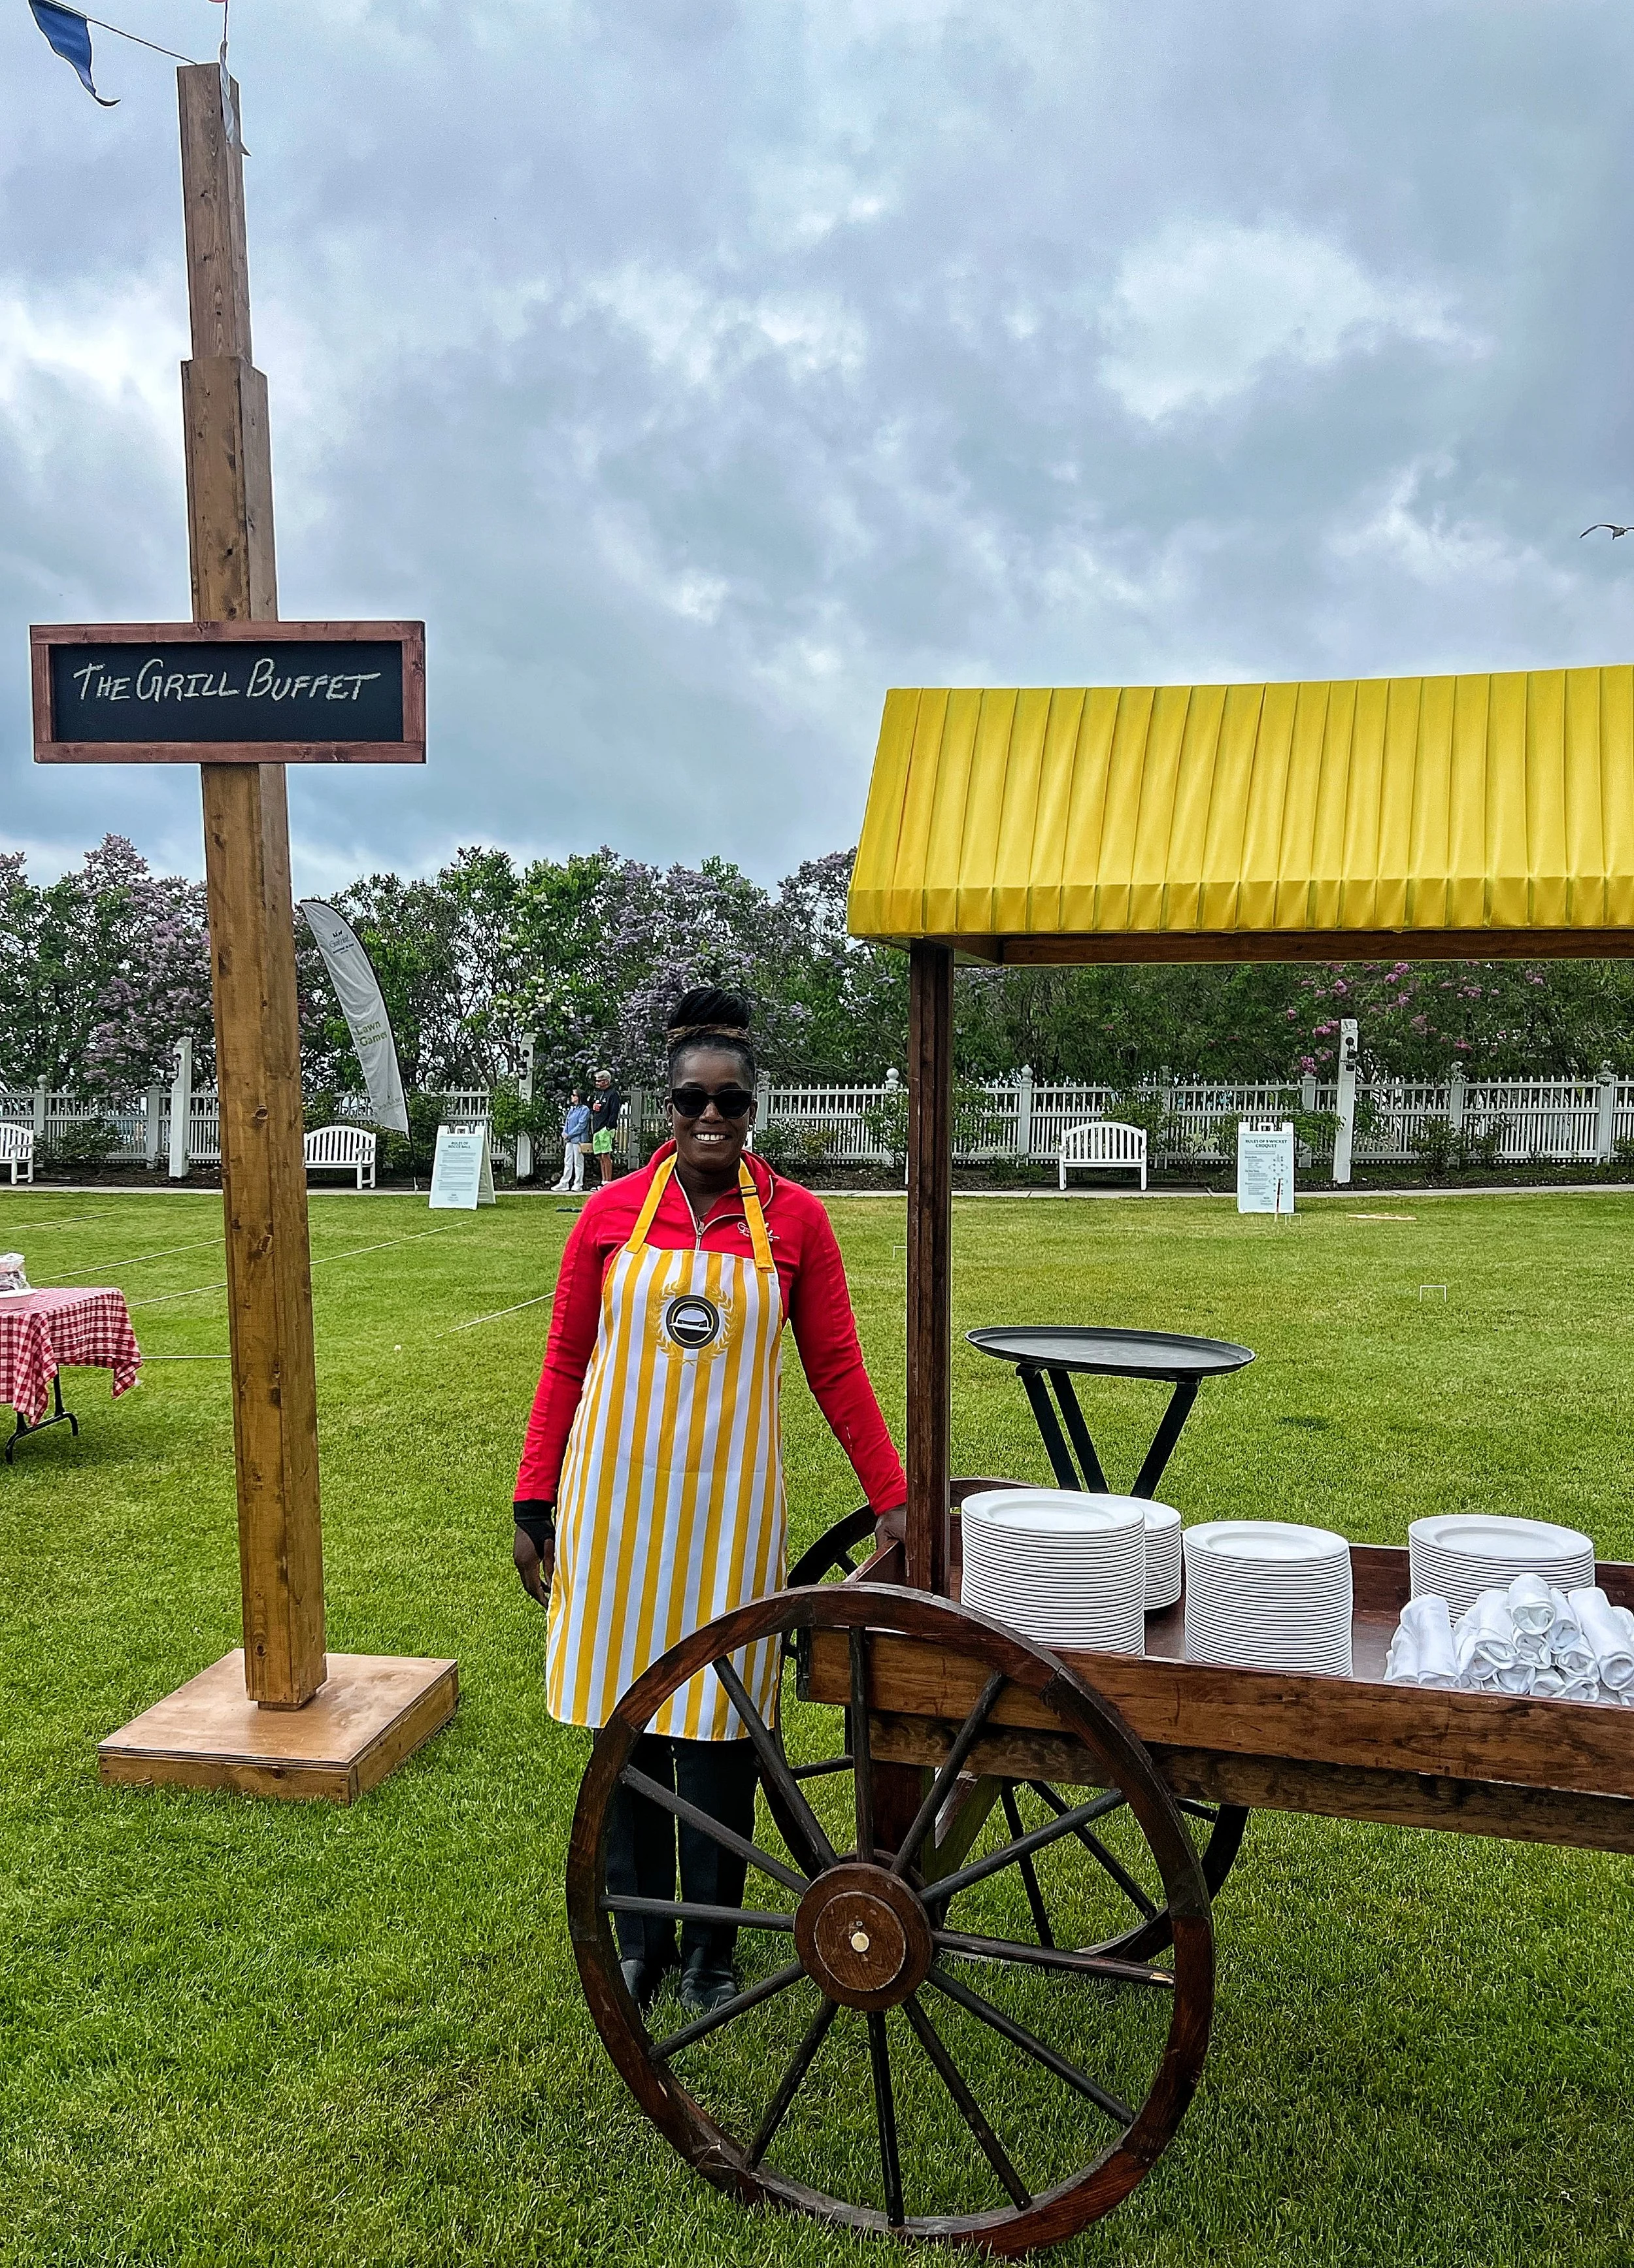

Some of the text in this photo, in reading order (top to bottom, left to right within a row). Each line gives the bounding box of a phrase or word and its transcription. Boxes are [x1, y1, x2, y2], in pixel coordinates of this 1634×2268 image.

[73, 658, 381, 702] THE GRILL BUFFET
[354, 1021, 380, 1035] Lawn
[360, 1031, 387, 1046] Games
